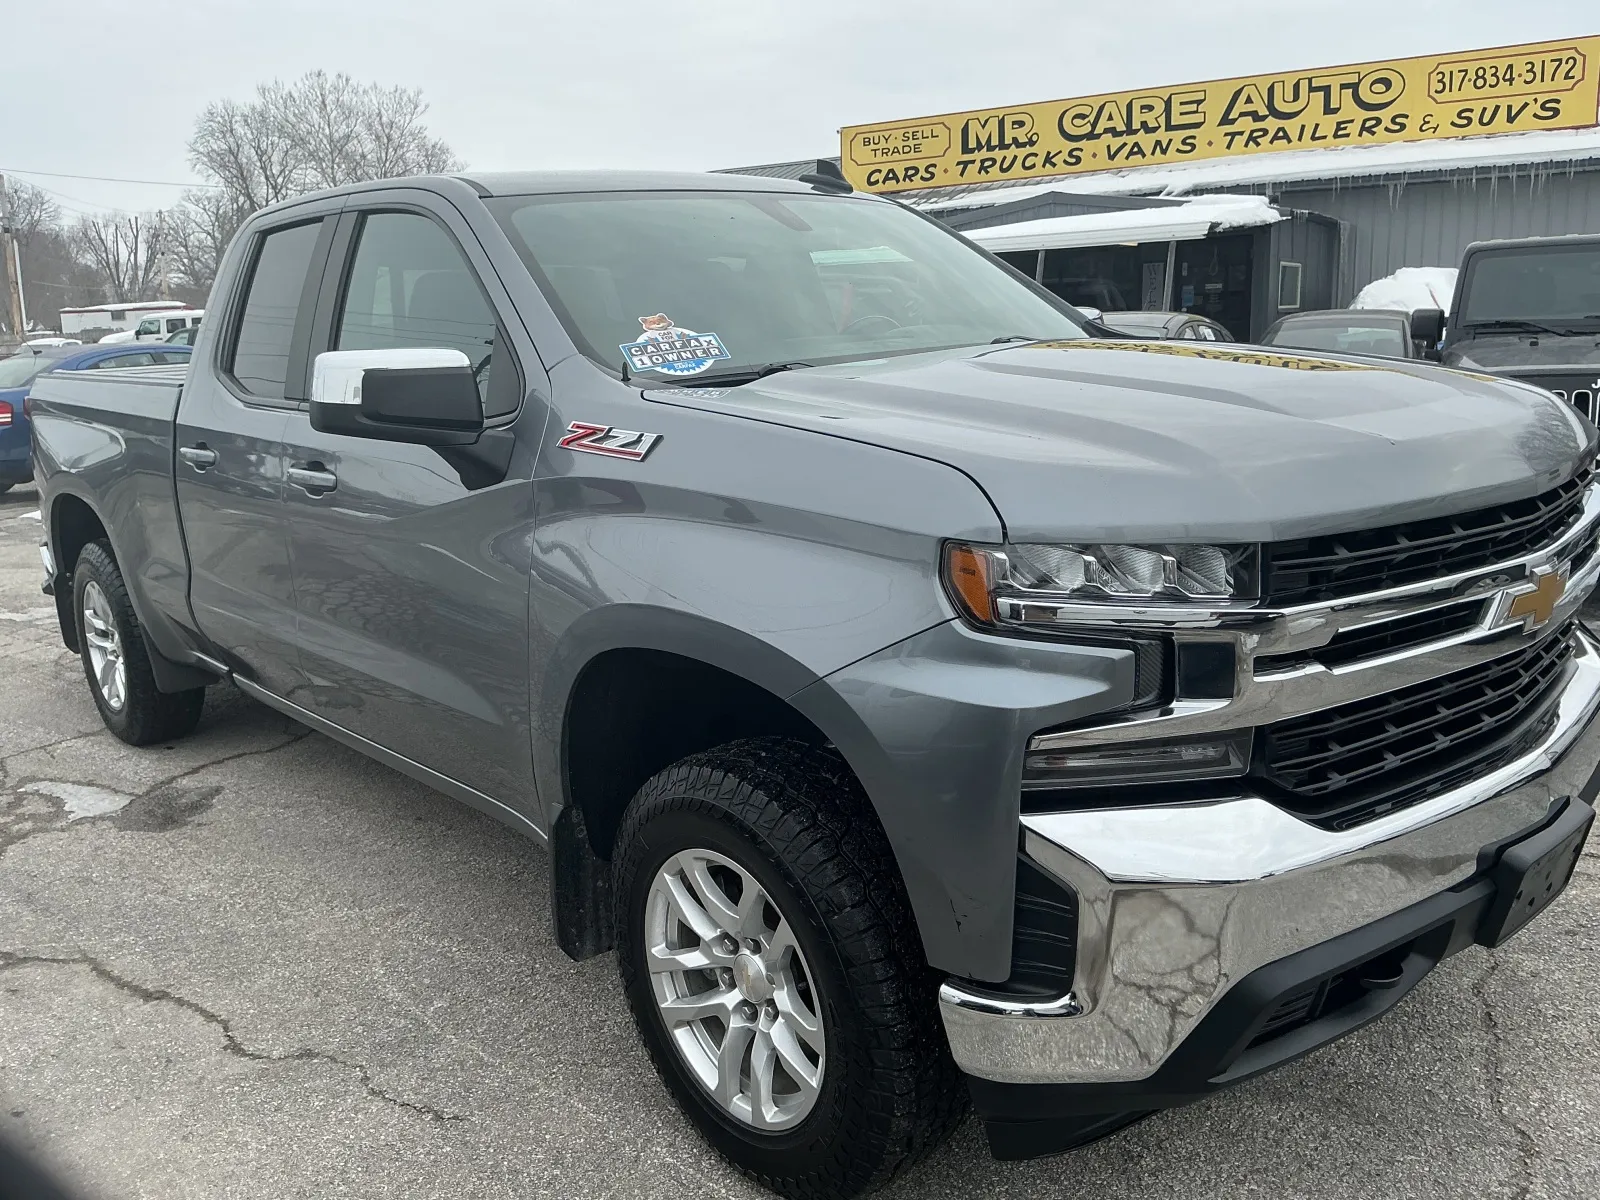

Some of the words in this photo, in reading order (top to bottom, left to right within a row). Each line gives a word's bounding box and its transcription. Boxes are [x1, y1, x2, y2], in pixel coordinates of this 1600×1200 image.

[961, 112, 1040, 155] MR.
[1057, 89, 1207, 142] CARE
[1217, 67, 1406, 127] AUTO
[865, 163, 937, 187] CARS
[955, 146, 1083, 179] TRUCKS
[1105, 134, 1198, 162] VANS
[1223, 112, 1410, 151] TRAILERS
[1418, 113, 1440, 135] &
[1450, 97, 1562, 129] SUV'S
[870, 143, 923, 159] TRADE
[630, 338, 715, 356] CARFAX
[635, 356, 648, 366] 1
[650, 347, 721, 364] OWNER
[556, 421, 664, 462] Z71
